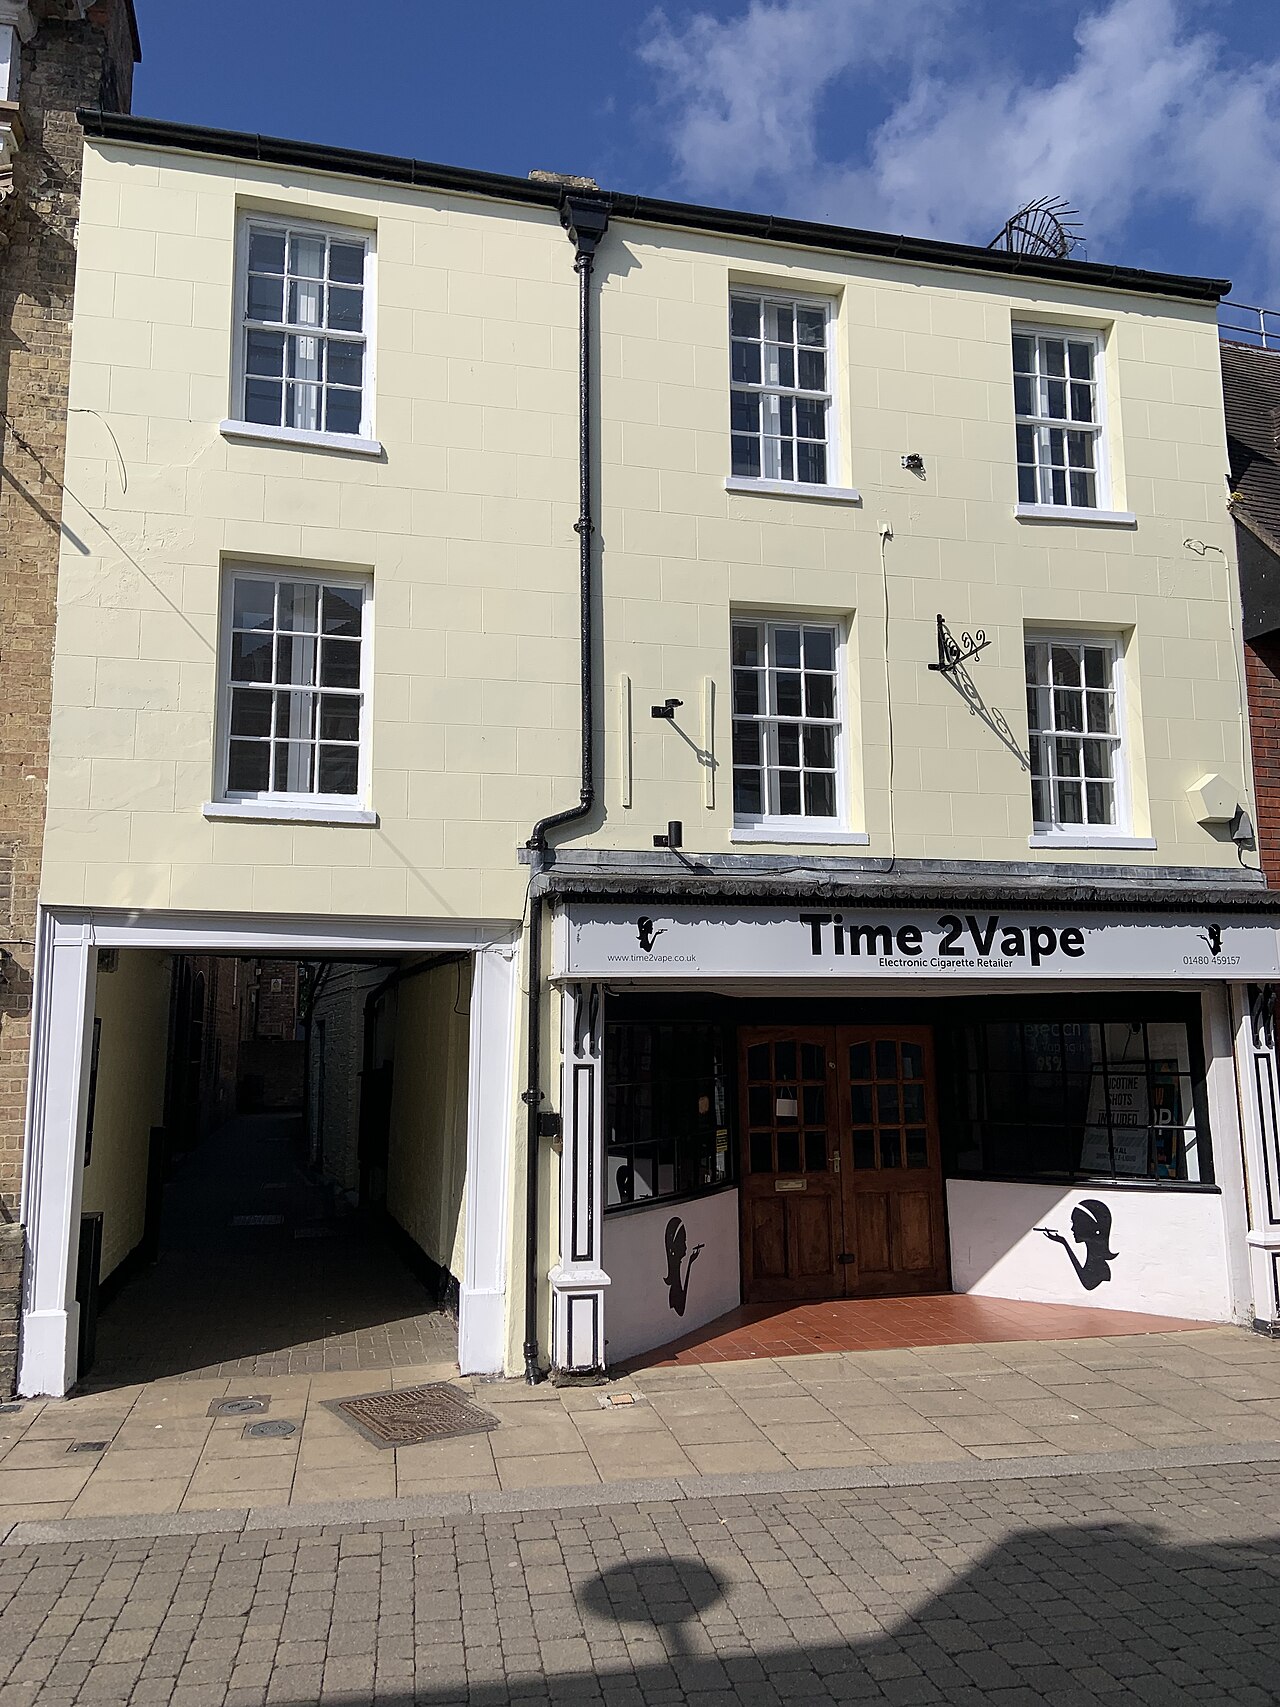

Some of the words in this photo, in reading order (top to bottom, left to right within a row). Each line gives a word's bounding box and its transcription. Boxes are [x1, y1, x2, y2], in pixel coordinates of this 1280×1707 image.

[799, 913, 923, 956] Time
[936, 914, 1086, 967] 2Vape
[607, 954, 697, 963] www.time2vape.co.uk
[879, 957, 928, 968] Electronic
[930, 957, 974, 970] Cigarette
[977, 958, 1013, 968] Retailer
[1182, 955, 1209, 965] 01480
[1212, 956, 1241, 965] 459157
[1098, 1112, 1138, 1125] INLUDED
